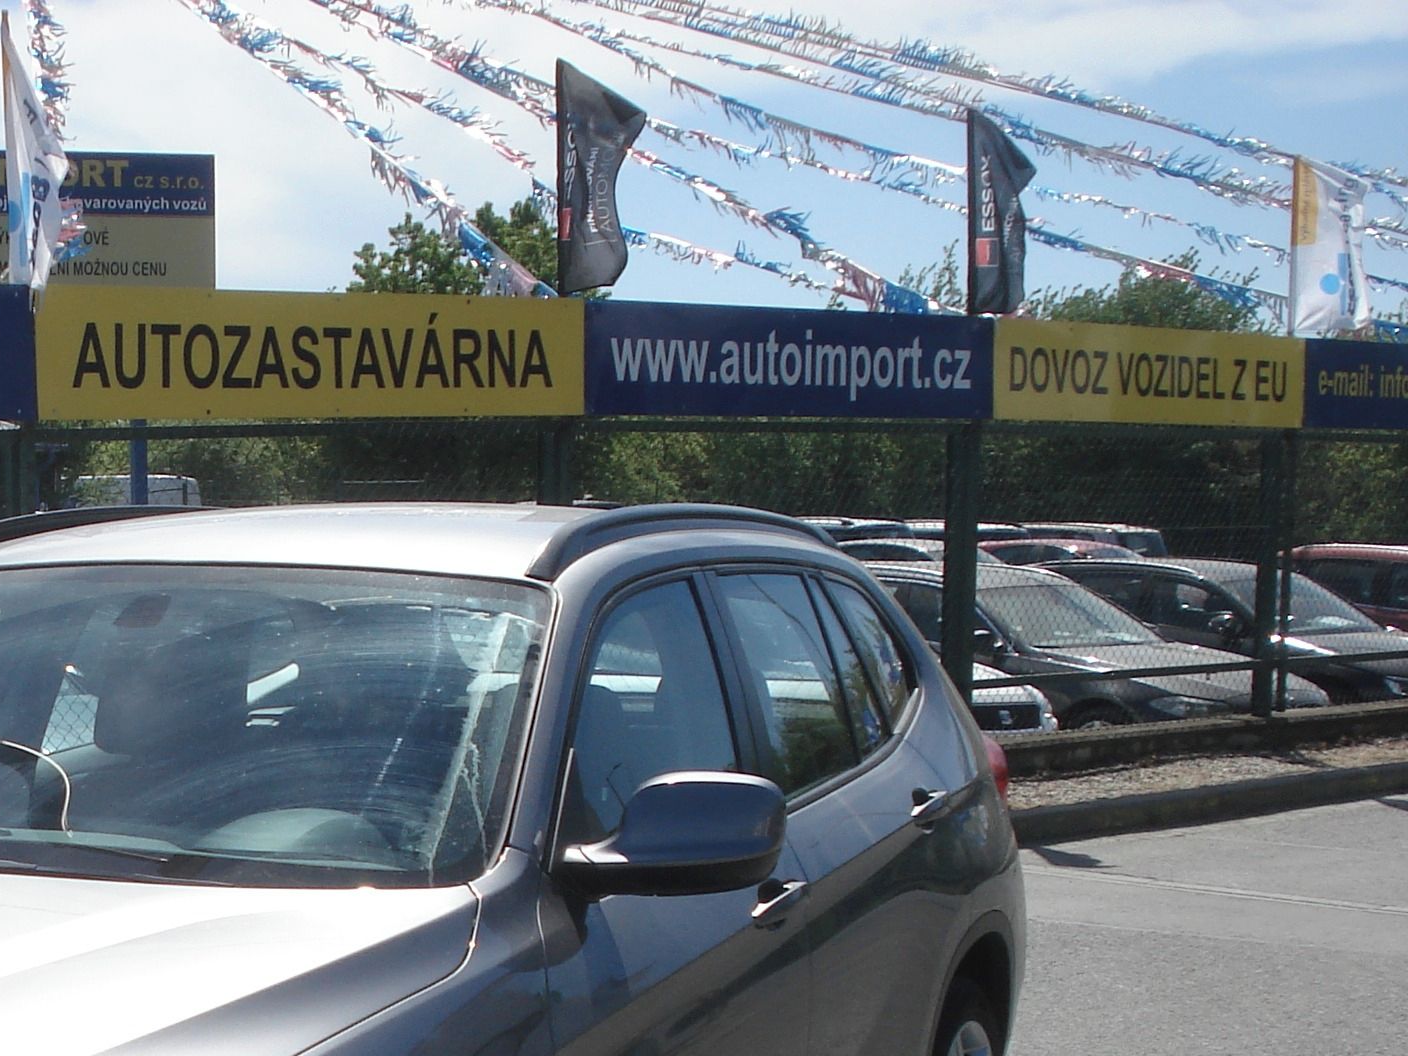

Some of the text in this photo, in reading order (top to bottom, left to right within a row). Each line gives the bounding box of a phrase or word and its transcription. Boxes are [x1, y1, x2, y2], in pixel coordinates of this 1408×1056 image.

[160, 175, 205, 189] s.r.o.
[173, 196, 207, 211] vozů
[73, 258, 128, 276] MOŽNOU
[133, 261, 167, 276] CENU
[73, 312, 554, 390] AUTOZASTAVÁRNA
[610, 329, 972, 402] www.autoimport.cz
[1009, 345, 1287, 402] DOVOZ VOZIDEL Z EU
[1318, 363, 1374, 397] e-mail:
